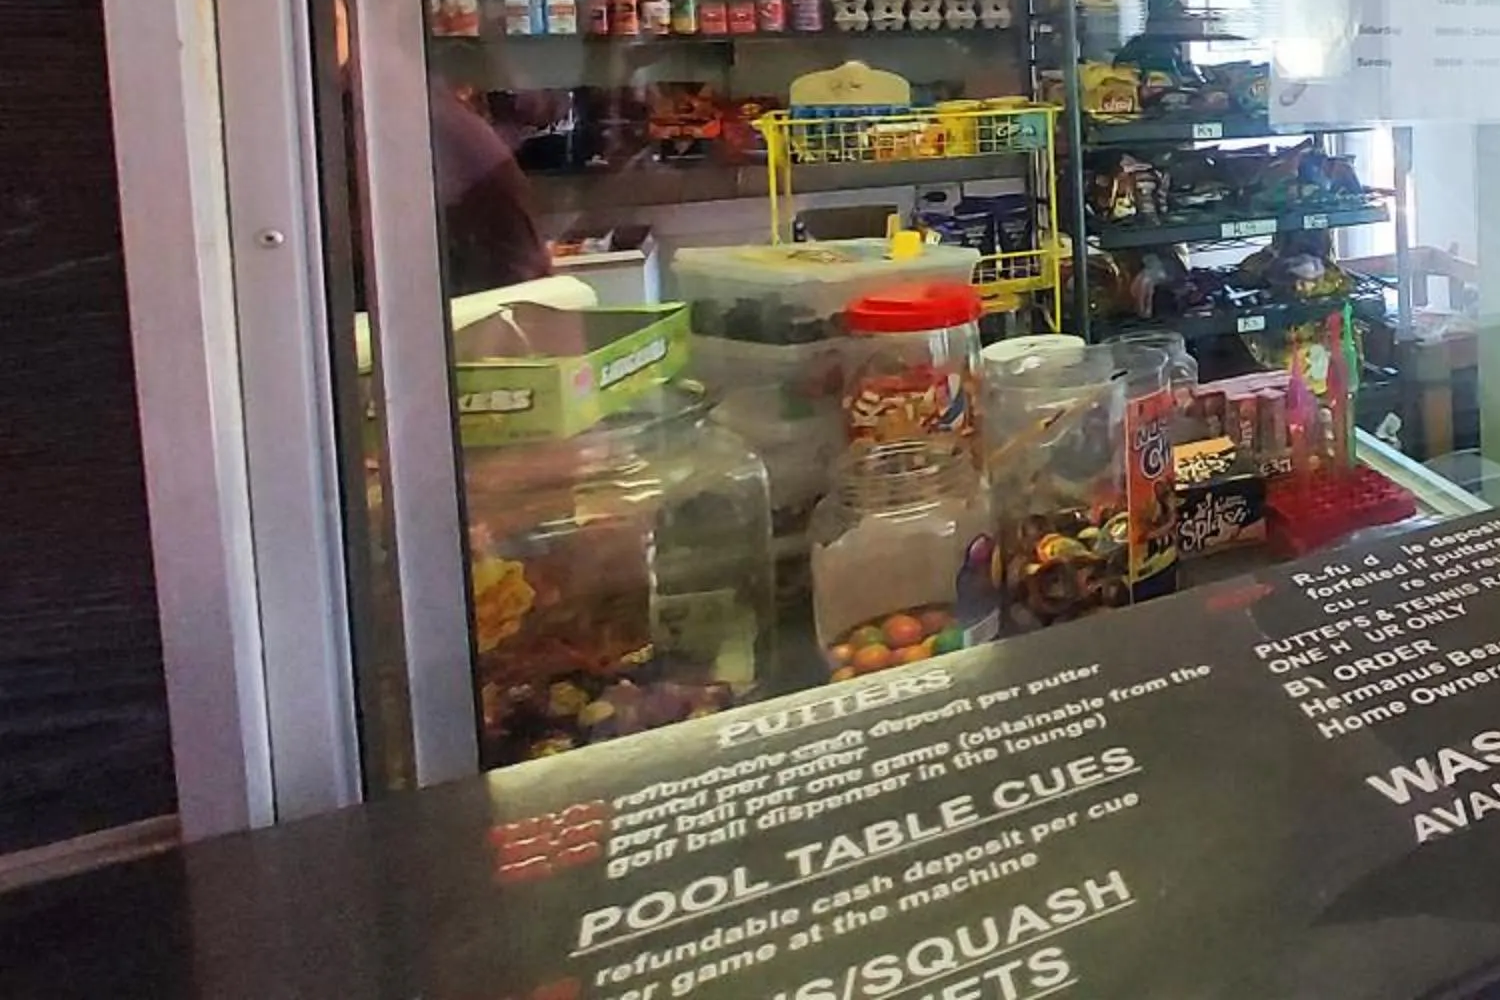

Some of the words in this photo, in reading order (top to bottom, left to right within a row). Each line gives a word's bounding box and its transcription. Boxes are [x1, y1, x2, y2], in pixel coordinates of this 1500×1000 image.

[1306, 562, 1409, 600] forfeited
[1411, 556, 1429, 570] if
[1375, 608, 1396, 622] &
[1395, 582, 1480, 614] TENNIS
[1430, 566, 1471, 583] not
[1268, 647, 1329, 674] ONE
[1330, 623, 1405, 655] HUR
[1406, 602, 1468, 630] ONLY
[1333, 638, 1439, 681] ORDER
[718, 666, 953, 748] PUTTERS
[1299, 660, 1447, 718] Hermanus
[1317, 700, 1408, 740] Home
[608, 823, 669, 855] per
[677, 801, 736, 833] ball
[745, 786, 798, 816] per
[806, 768, 864, 795] one
[871, 740, 950, 779] game
[957, 695, 1106, 751] (obtainable
[1109, 677, 1168, 703] from
[1170, 663, 1212, 687] the
[613, 751, 786, 809] refundable
[791, 728, 864, 763] cash
[867, 697, 972, 739] deposit
[977, 686, 1021, 710] per
[1027, 663, 1101, 696] putter
[686, 819, 748, 853] ball
[757, 771, 912, 829] dispenser
[919, 759, 949, 782] in
[952, 746, 999, 770] the
[1004, 712, 1108, 755] lounge)
[715, 775, 770, 803] per
[777, 746, 869, 786] putter
[577, 865, 770, 949] POOL
[784, 794, 980, 877] TABLE
[991, 746, 1136, 810] CUES
[595, 906, 800, 987] refundable
[811, 875, 894, 915] cash
[903, 825, 1025, 883] deposit
[1029, 811, 1079, 843] per
[1087, 792, 1141, 820] cue
[607, 982, 659, 1000] er
[670, 941, 778, 998] game
[789, 921, 824, 951] at
[833, 901, 888, 935] the
[899, 851, 1039, 912] machine
